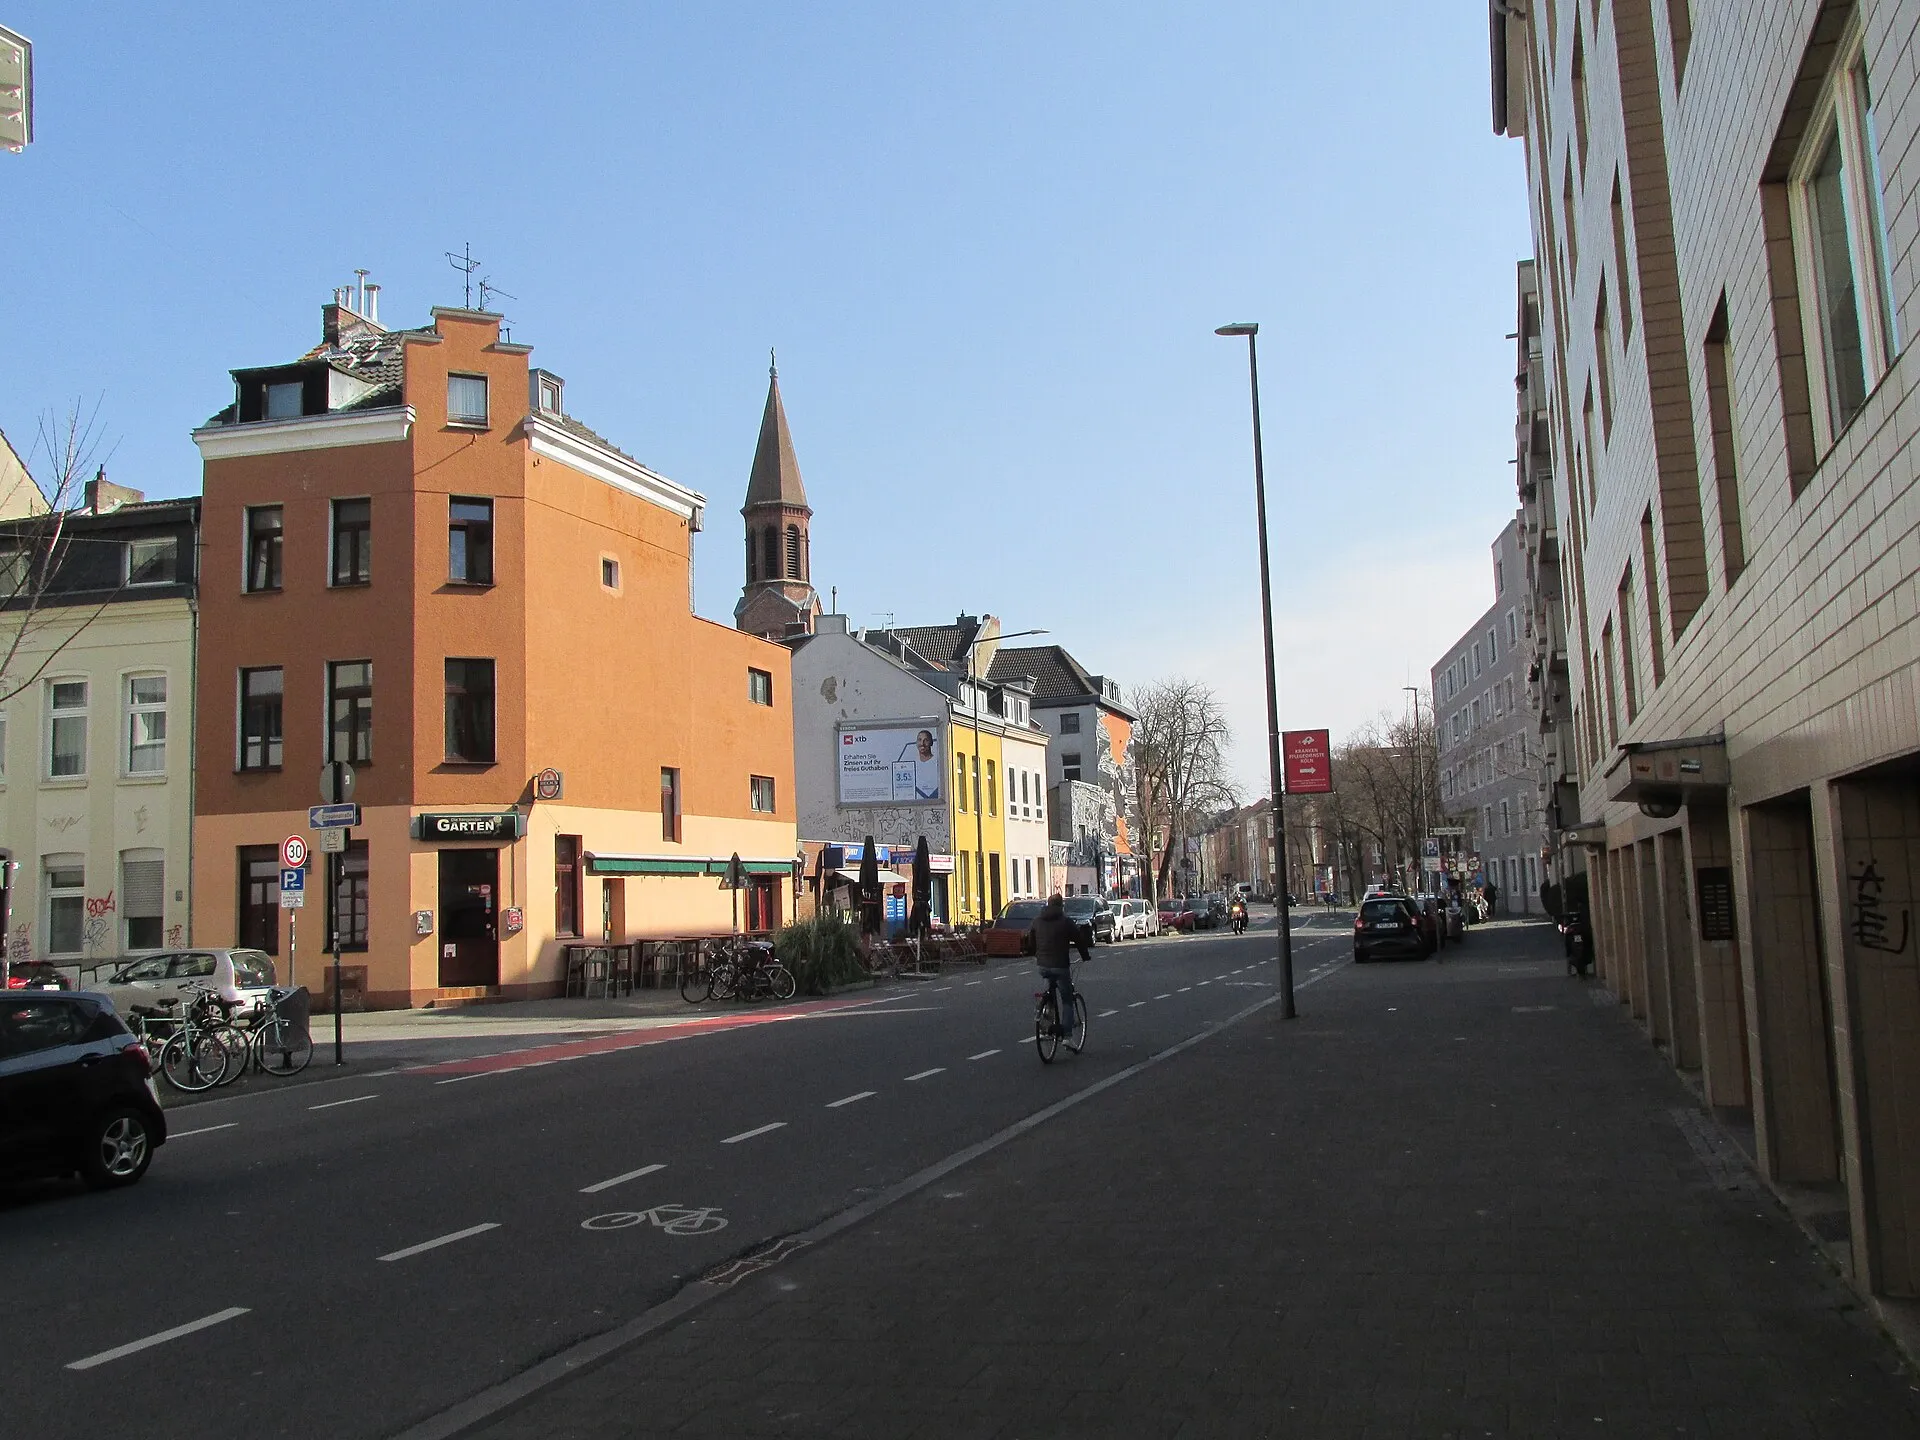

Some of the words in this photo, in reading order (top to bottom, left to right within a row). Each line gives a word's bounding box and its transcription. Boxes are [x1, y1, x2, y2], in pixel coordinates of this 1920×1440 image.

[855, 735, 867, 743] xtb
[288, 844, 302, 859] 30
[284, 871, 298, 888] P
